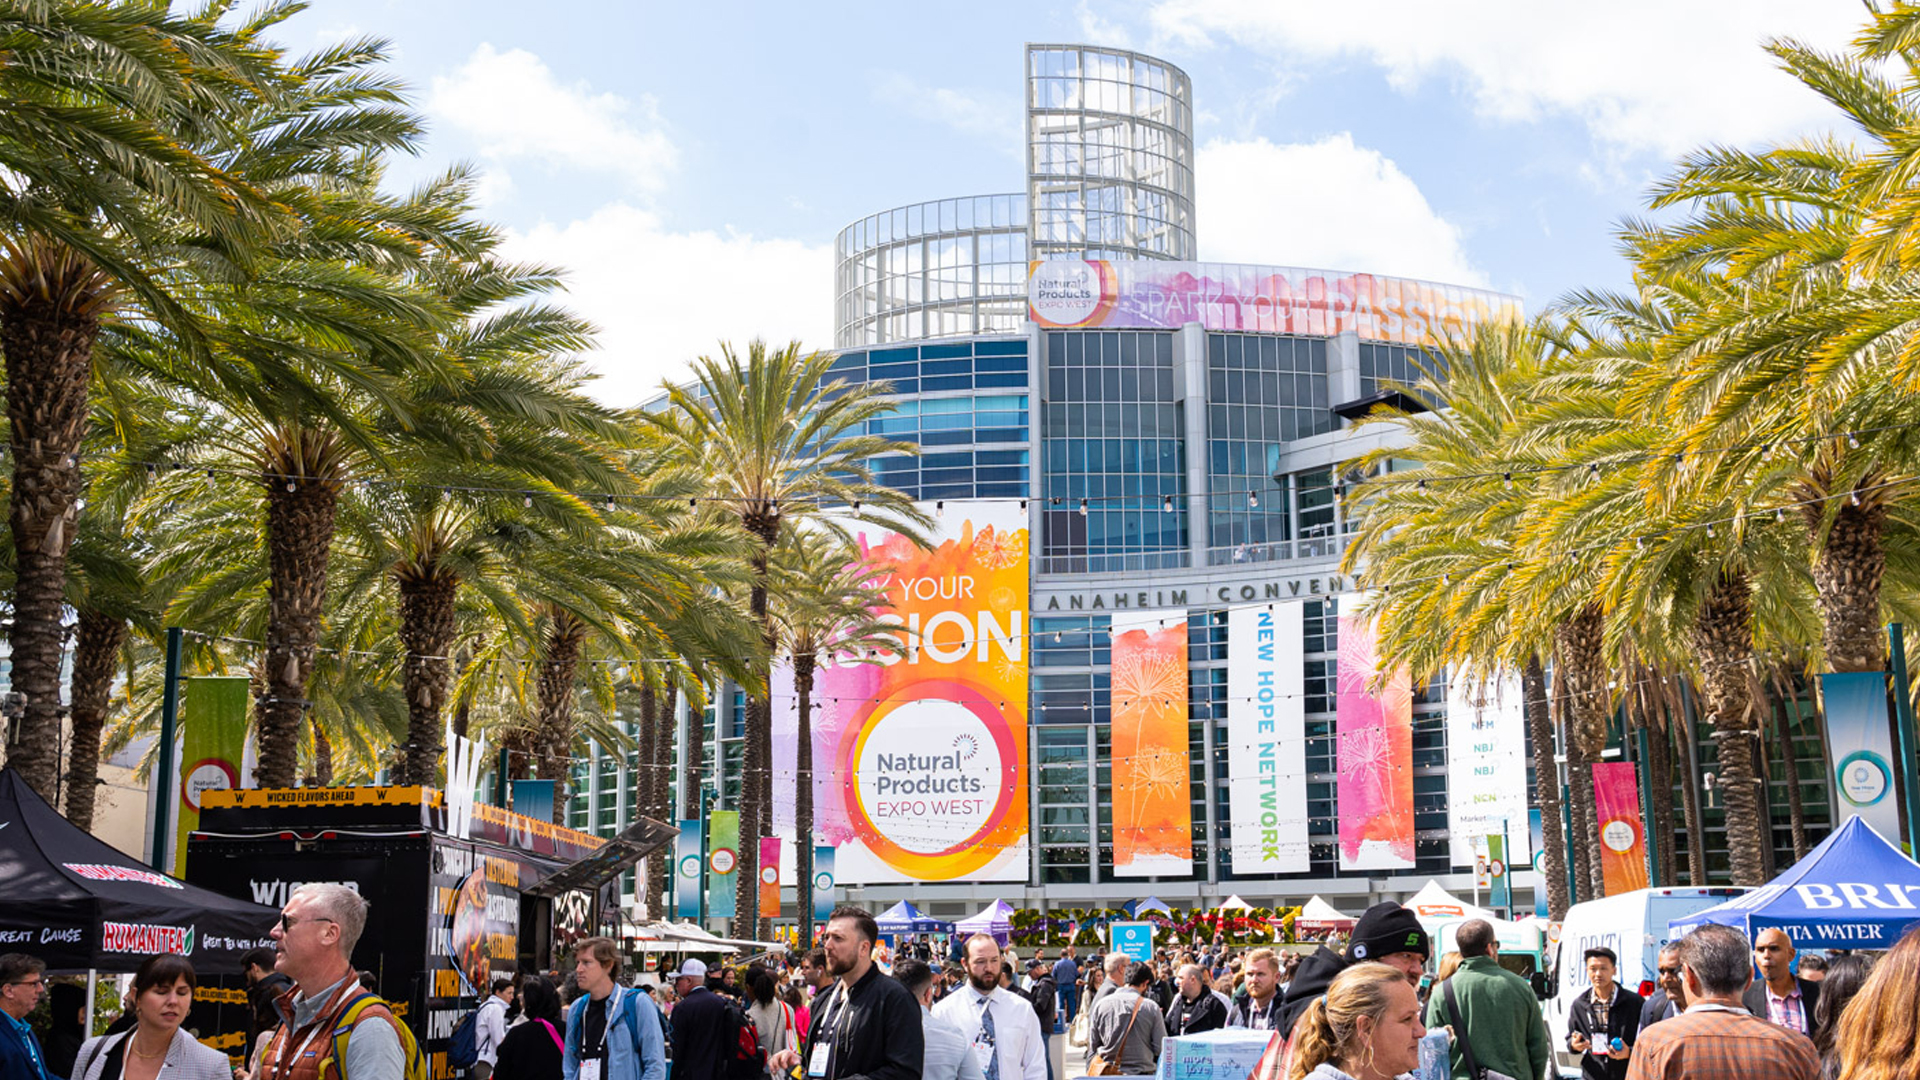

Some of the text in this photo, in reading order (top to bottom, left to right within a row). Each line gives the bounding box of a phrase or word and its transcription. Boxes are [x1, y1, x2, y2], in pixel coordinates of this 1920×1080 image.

[1039, 279, 1081, 289] Natural
[1038, 290, 1091, 299] Products
[1039, 300, 1092, 309] EXPO WEST
[1130, 290, 1224, 316] SPARK
[1232, 293, 1311, 319] YOUR
[899, 576, 975, 600] YOUR
[1047, 589, 1188, 610] ANAHEIM
[852, 610, 1022, 668] SION
[1257, 612, 1280, 863] NEW HOPE NETWORK
[1474, 743, 1494, 753] NBJ
[877, 750, 961, 772] Natural
[1474, 766, 1495, 775] NBJ
[877, 774, 981, 795] Products
[234, 789, 387, 803] W WICKED FLAVORS AHEAD W
[1473, 793, 1497, 803] NCN
[877, 799, 984, 817] EXPO WEST
[40, 927, 82, 944] CAUSE
[103, 921, 186, 954] HUMANITEA
[1756, 924, 1883, 940] ITA WATER
[435, 969, 459, 997] PUNCH
